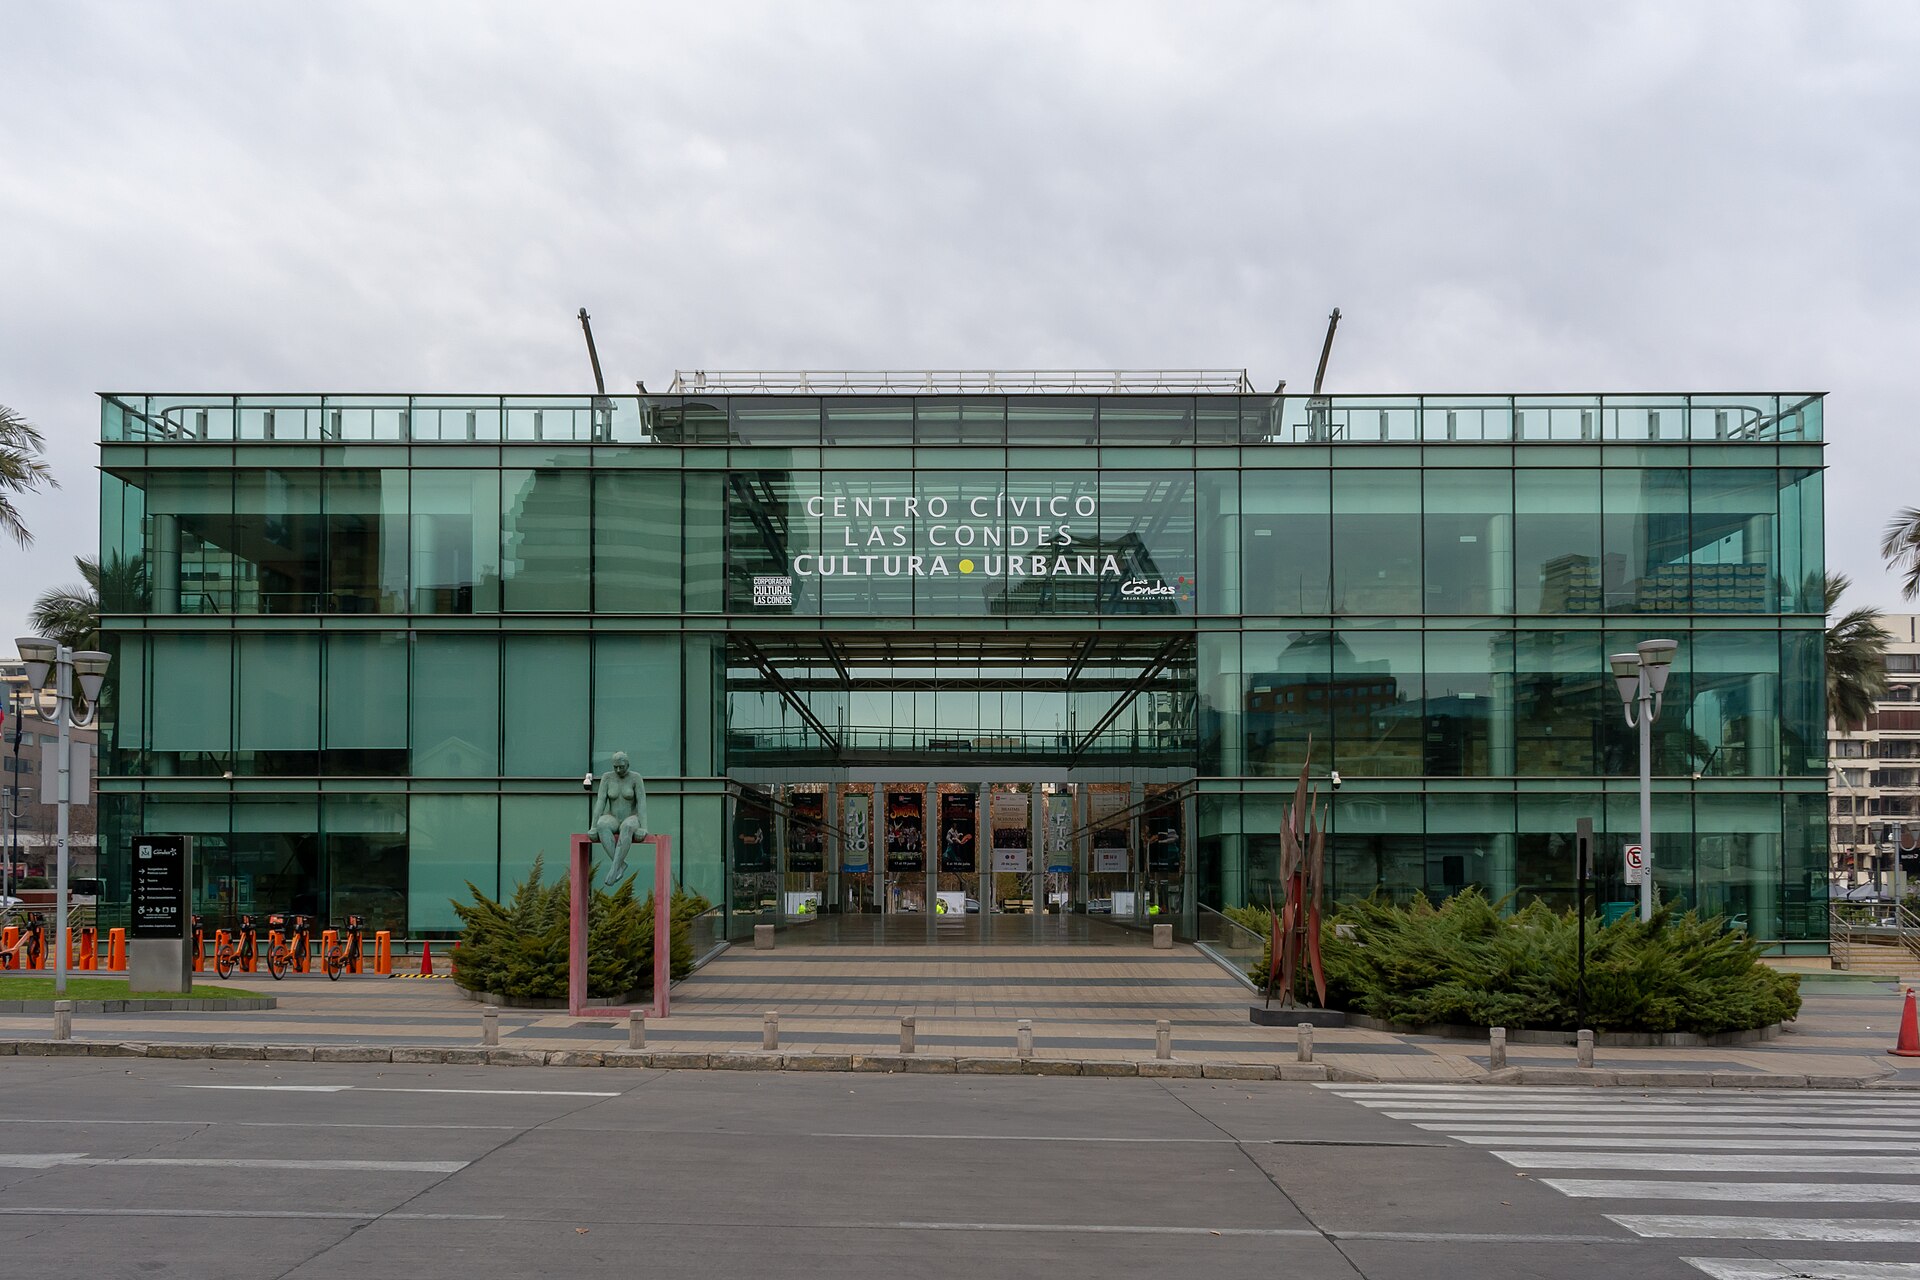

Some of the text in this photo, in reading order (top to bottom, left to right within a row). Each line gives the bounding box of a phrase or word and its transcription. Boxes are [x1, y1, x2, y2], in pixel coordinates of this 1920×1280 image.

[806, 491, 1096, 518] CENTRO CÍVICO
[845, 525, 1072, 547] LAS CONDES
[793, 555, 1122, 576] CULTURA URBANA
[1121, 580, 1175, 594] Condes
[1132, 577, 1148, 585] Las
[754, 585, 792, 595] CULTURAL
[754, 596, 792, 604] LAS CONDES
[58, 839, 64, 847] 5
